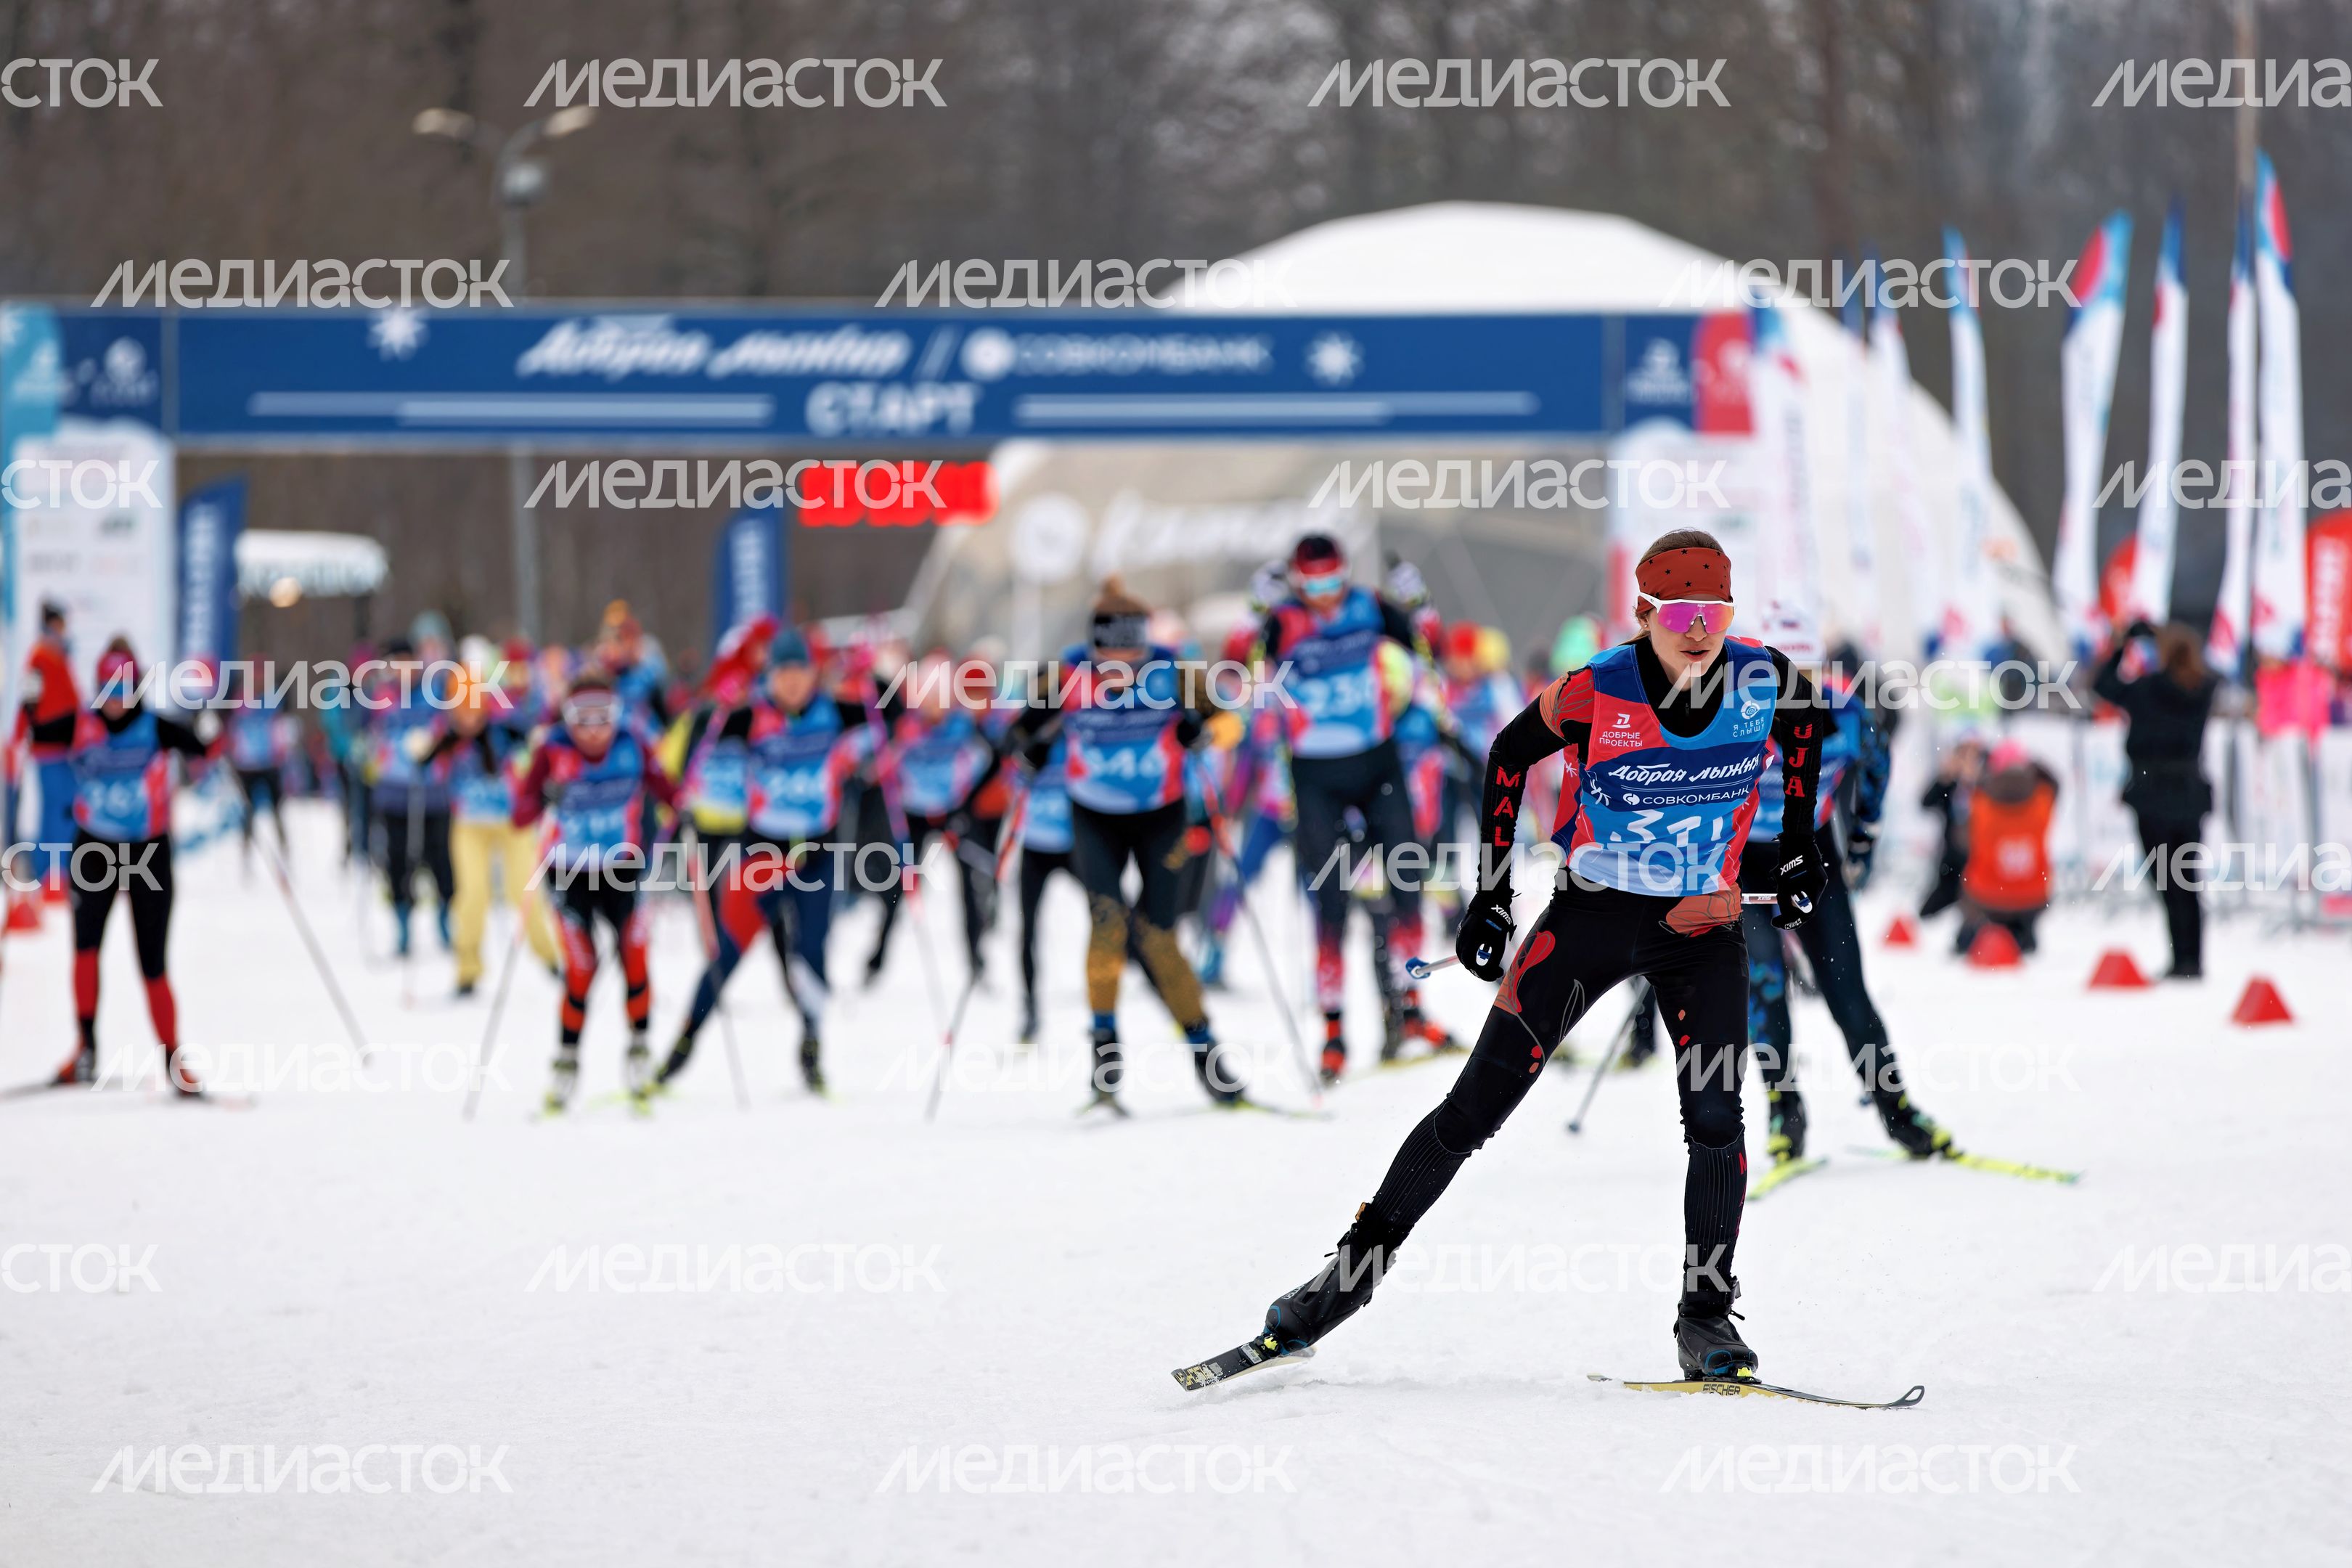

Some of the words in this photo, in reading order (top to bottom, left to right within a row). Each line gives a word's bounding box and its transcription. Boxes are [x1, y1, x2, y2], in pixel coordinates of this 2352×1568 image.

[1599, 738, 1643, 747] ПРОЕКТЫ
[1642, 785, 1750, 804] СОВКОМБАНК
[1702, 1384, 1741, 1395] FISCHER
